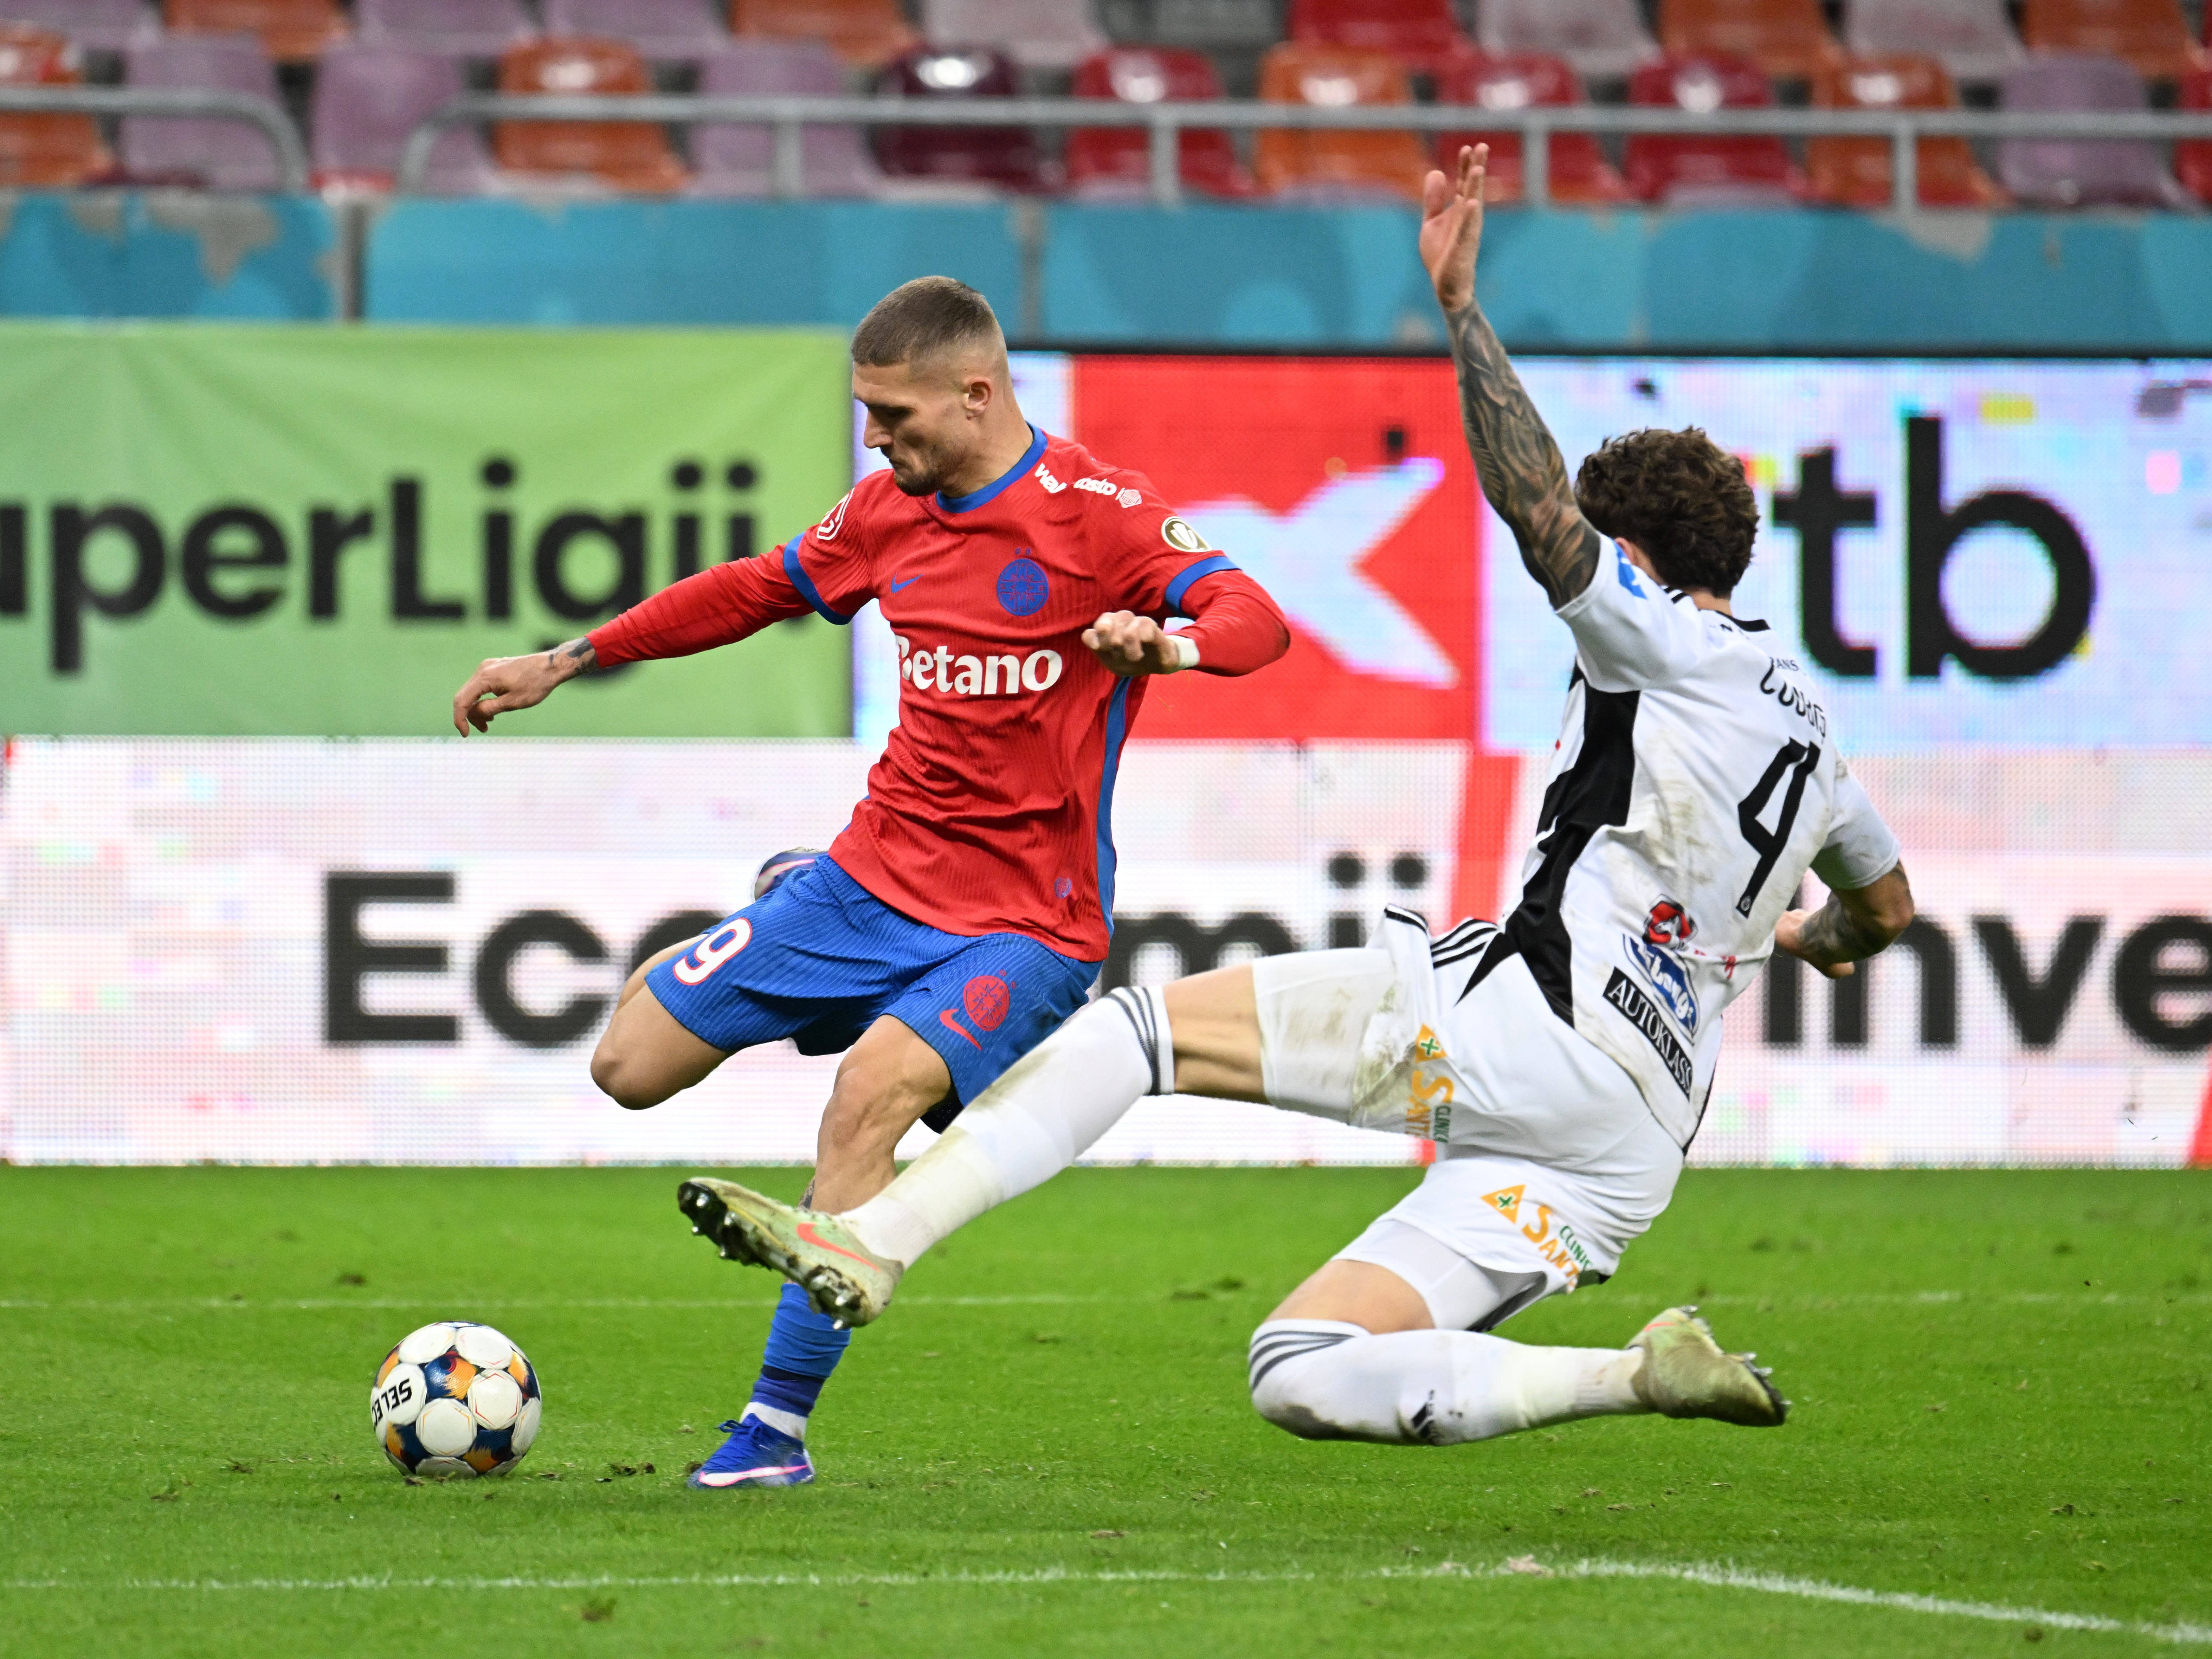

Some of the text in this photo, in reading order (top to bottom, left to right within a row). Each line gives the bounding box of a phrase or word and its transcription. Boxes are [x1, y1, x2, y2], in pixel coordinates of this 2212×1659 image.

[0, 459, 813, 677] perLigii
[1772, 415, 2097, 680] tb
[1735, 736, 1821, 919] 4
[673, 917, 753, 986] 9
[1521, 1203, 1580, 1289] SANT
